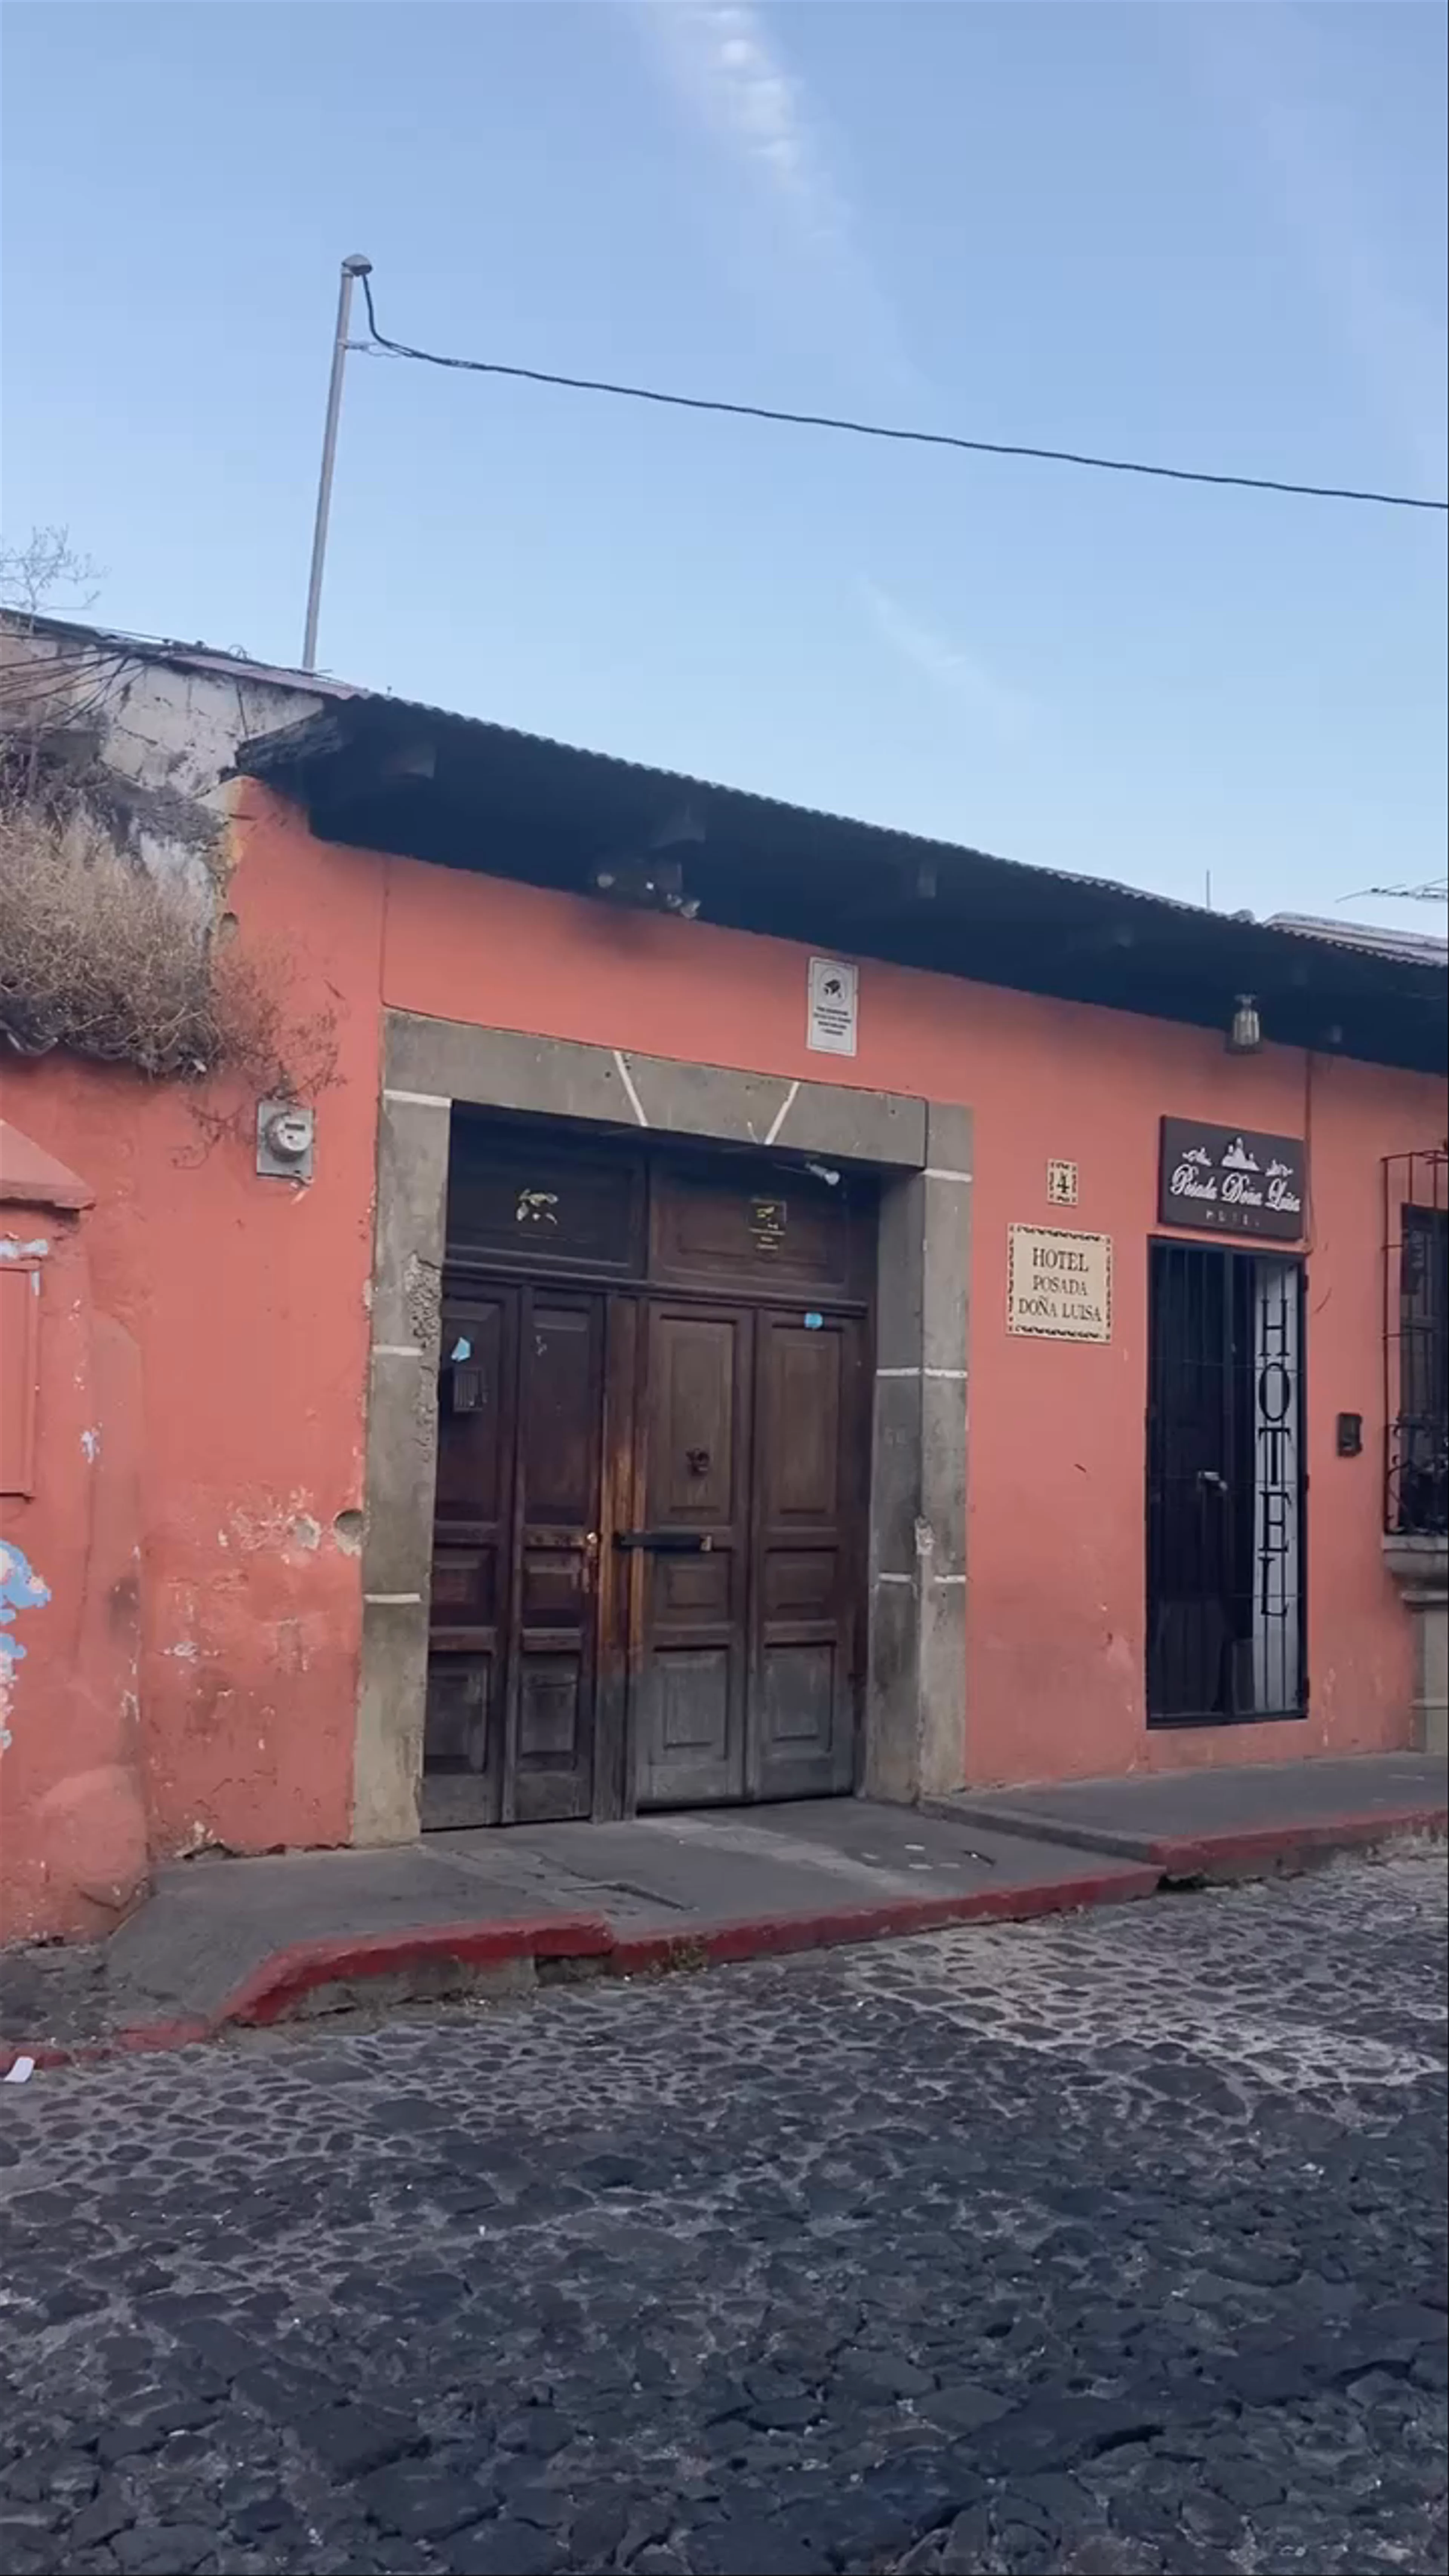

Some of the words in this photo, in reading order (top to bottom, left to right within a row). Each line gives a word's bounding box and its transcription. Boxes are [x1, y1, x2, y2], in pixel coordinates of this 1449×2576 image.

[1056, 1173, 1069, 1193] 4
[1032, 1247, 1088, 1272] HOTEL
[1033, 1275, 1088, 1296] POSADA
[1019, 1295, 1057, 1318] DOÑA
[1062, 1303, 1102, 1322] LUISA
[1258, 1298, 1291, 1616] HOTEL
